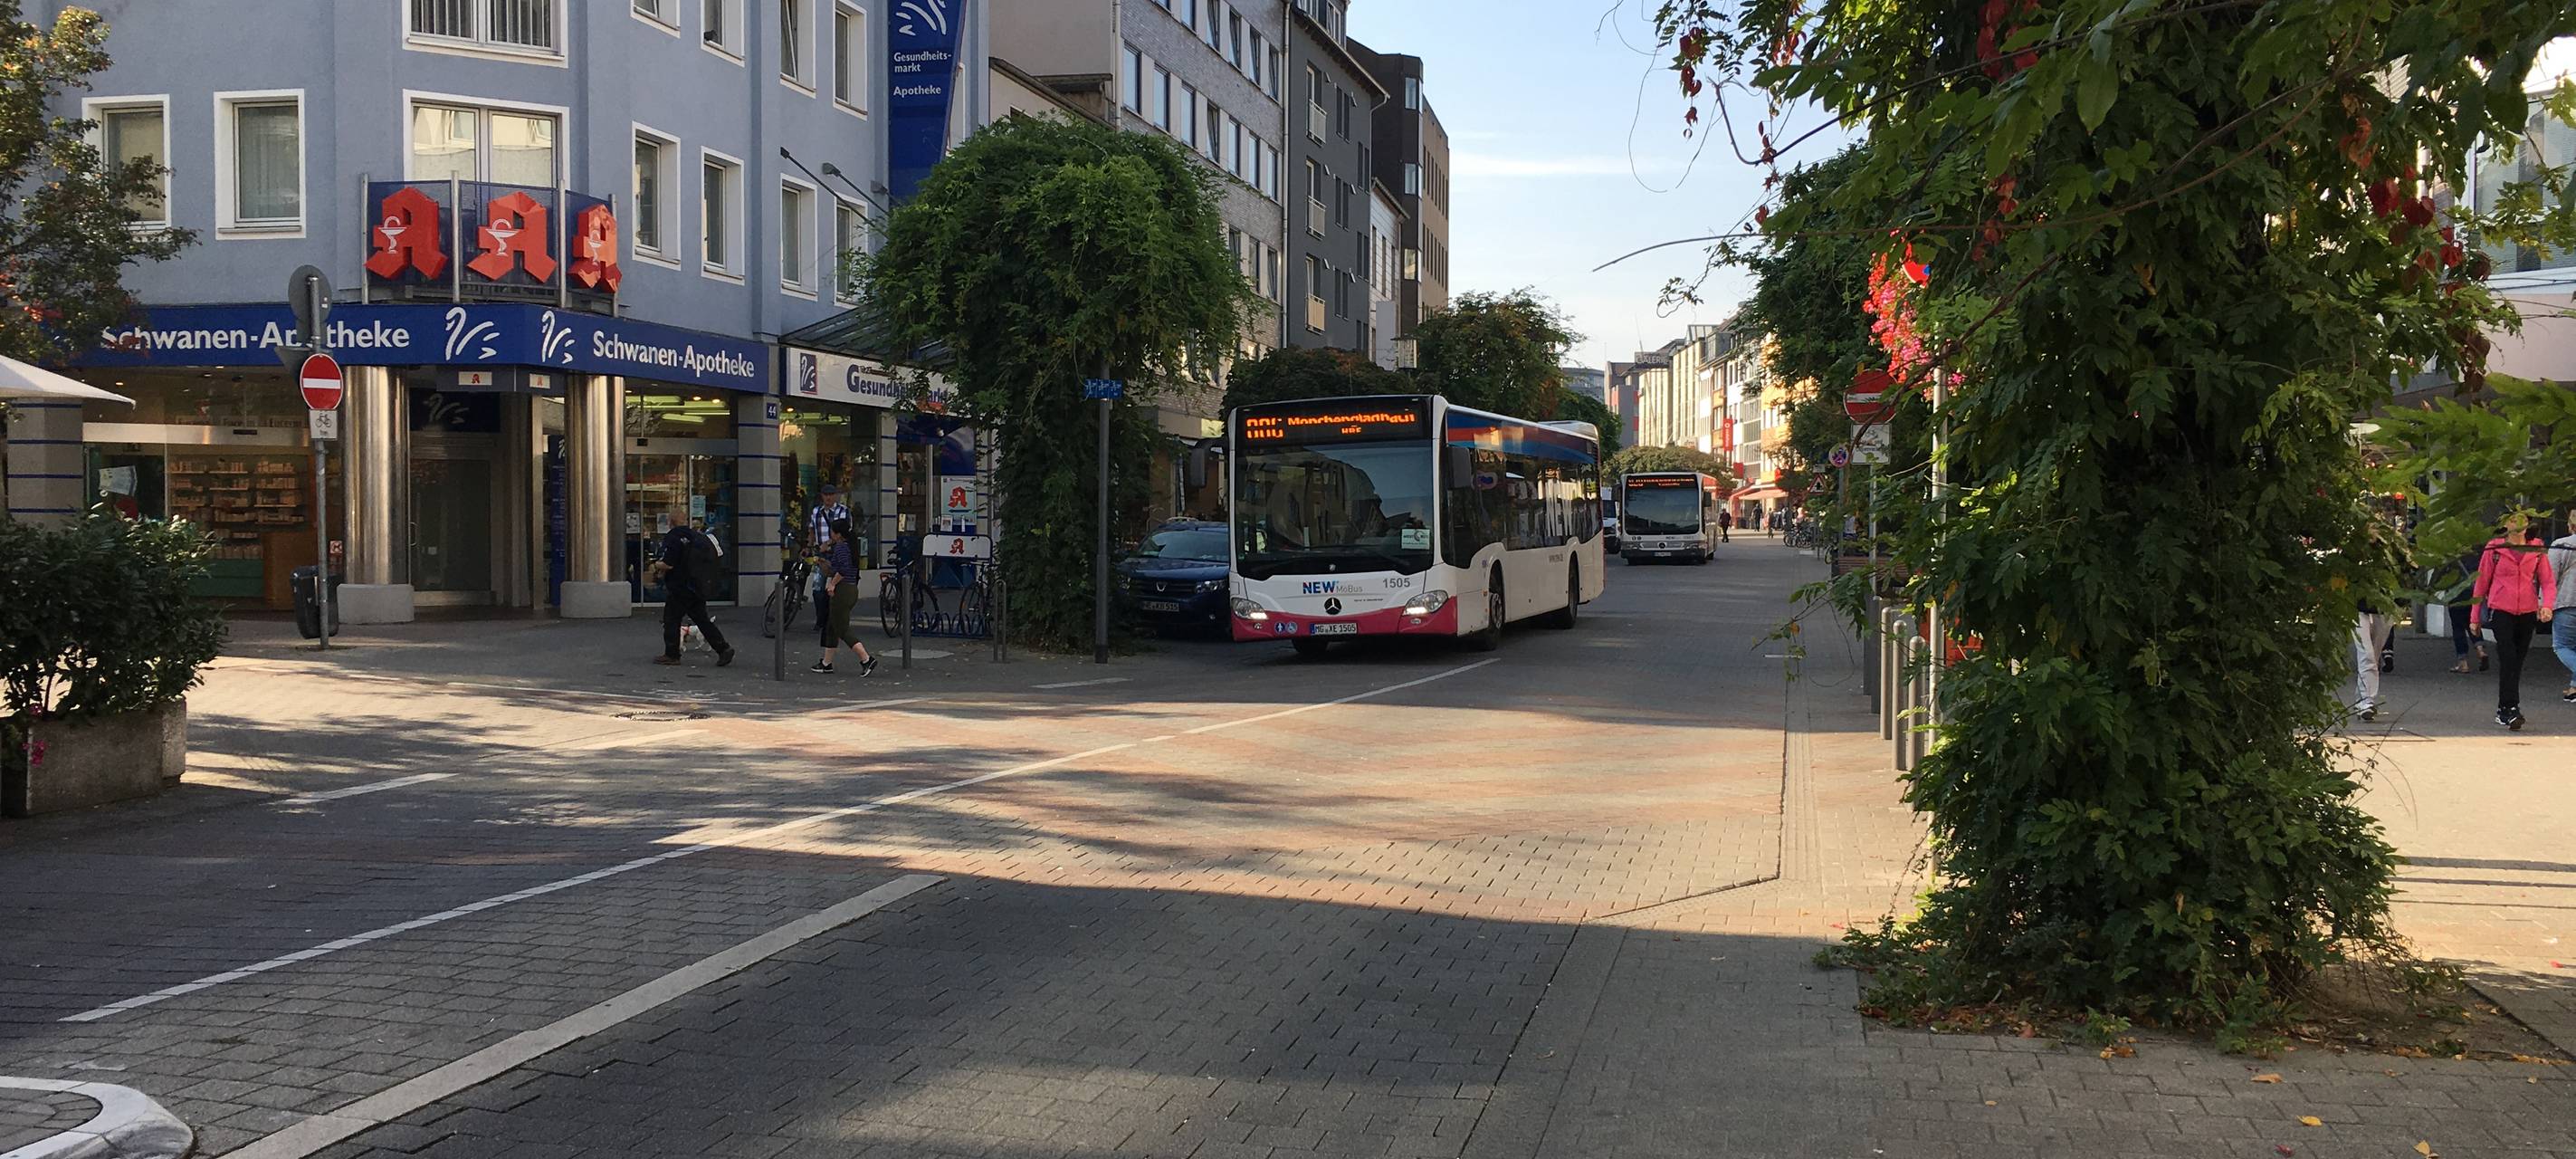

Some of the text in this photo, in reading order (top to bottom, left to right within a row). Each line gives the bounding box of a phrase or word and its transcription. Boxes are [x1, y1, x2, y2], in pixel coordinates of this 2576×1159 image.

[893, 50, 952, 62] Gesundheits-
[894, 62, 921, 72] markt
[892, 84, 941, 98] Apotheke
[593, 330, 755, 378] Schwanen-Apotheke
[768, 406, 777, 416] 44
[1302, 580, 1336, 594] NEW
[1382, 578, 1411, 589] 1505
[1314, 625, 1324, 633] MG
[1339, 624, 1356, 632] 1505
